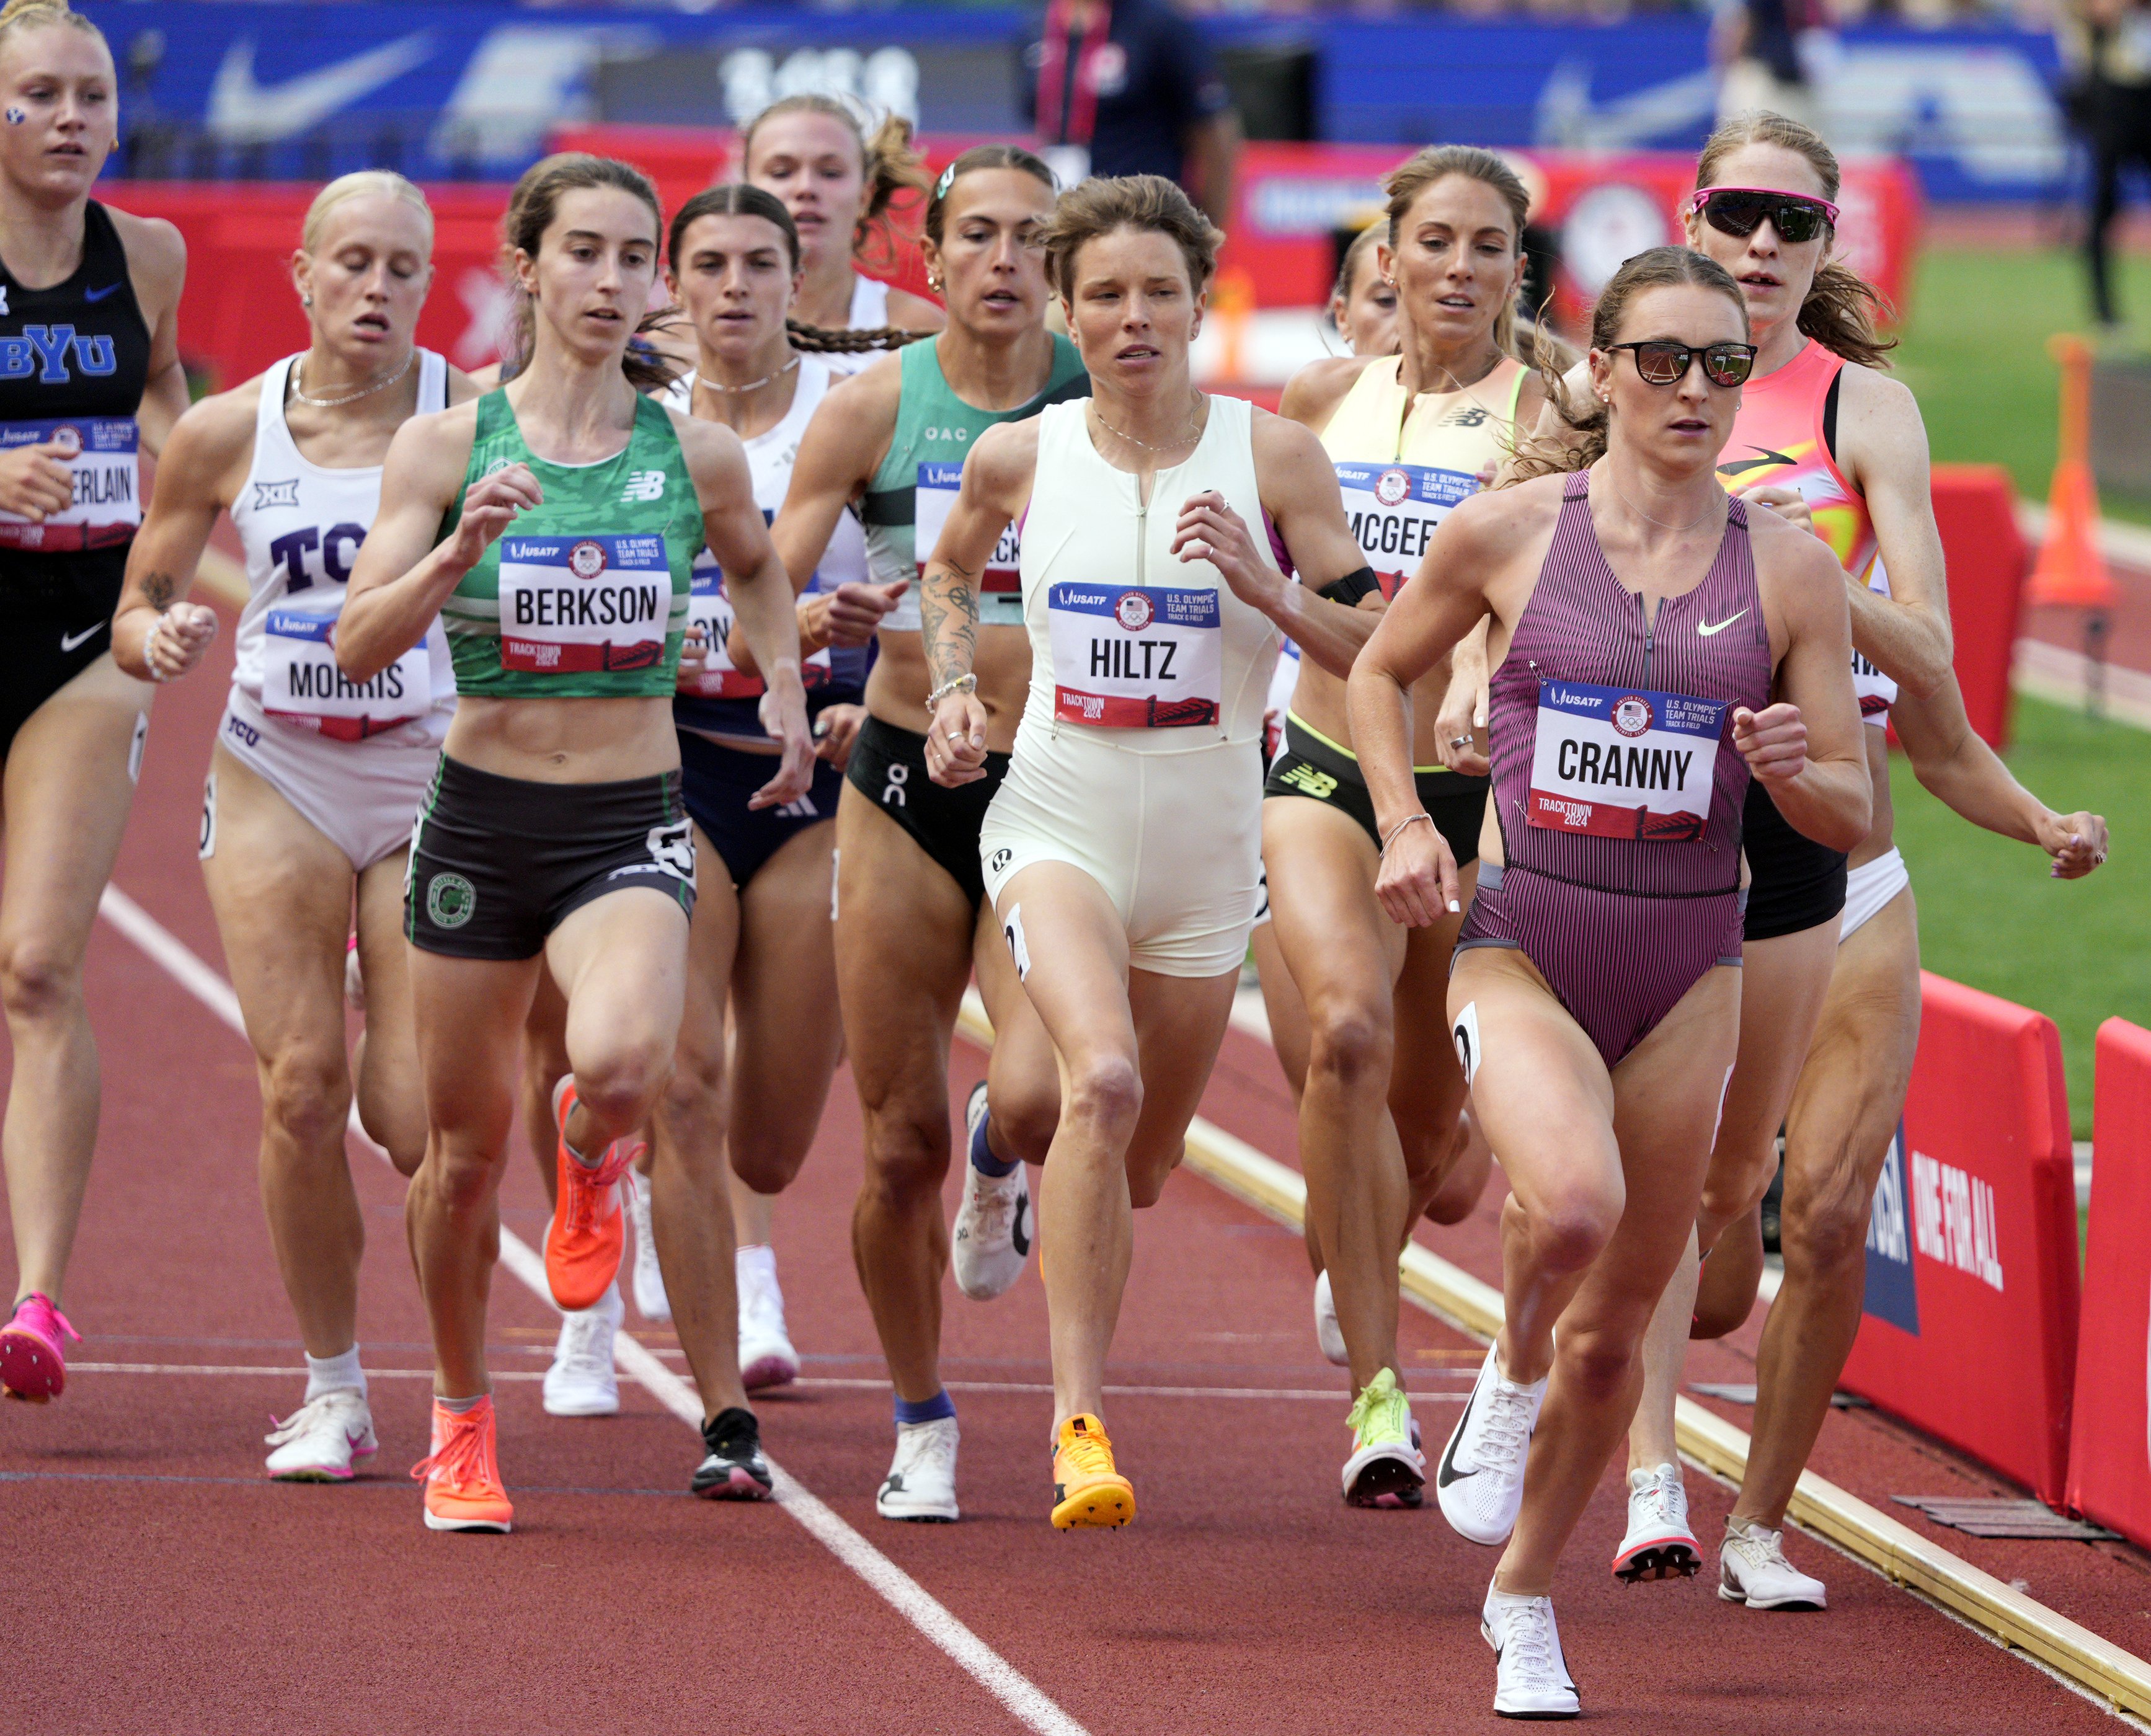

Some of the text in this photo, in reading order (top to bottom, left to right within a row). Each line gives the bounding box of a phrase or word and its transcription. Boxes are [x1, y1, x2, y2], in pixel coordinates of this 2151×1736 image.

[0, 324, 117, 384] BYU
[925, 427, 967, 441] OAC
[525, 547, 560, 557] USATF
[516, 585, 657, 626] BERKSON
[1073, 595, 1107, 605] USATF
[1167, 593, 1214, 604] U.S. OLYMPIC
[1167, 603, 1214, 614] TEAM TRIALS
[1091, 638, 1177, 680] HILTZ
[1062, 693, 1104, 711] TRACKTOWN
[1565, 695, 1603, 707] USATF
[1666, 699, 1717, 715] U.S. OLYMPIC
[1083, 707, 1101, 719] 2024
[1665, 710, 1715, 724] TEAM TRIALS
[1686, 722, 1700, 730] FIELD
[1558, 739, 1693, 791] CRANNY
[1538, 797, 1592, 817] TRACKTOWN
[1564, 812, 1587, 828] 2024
